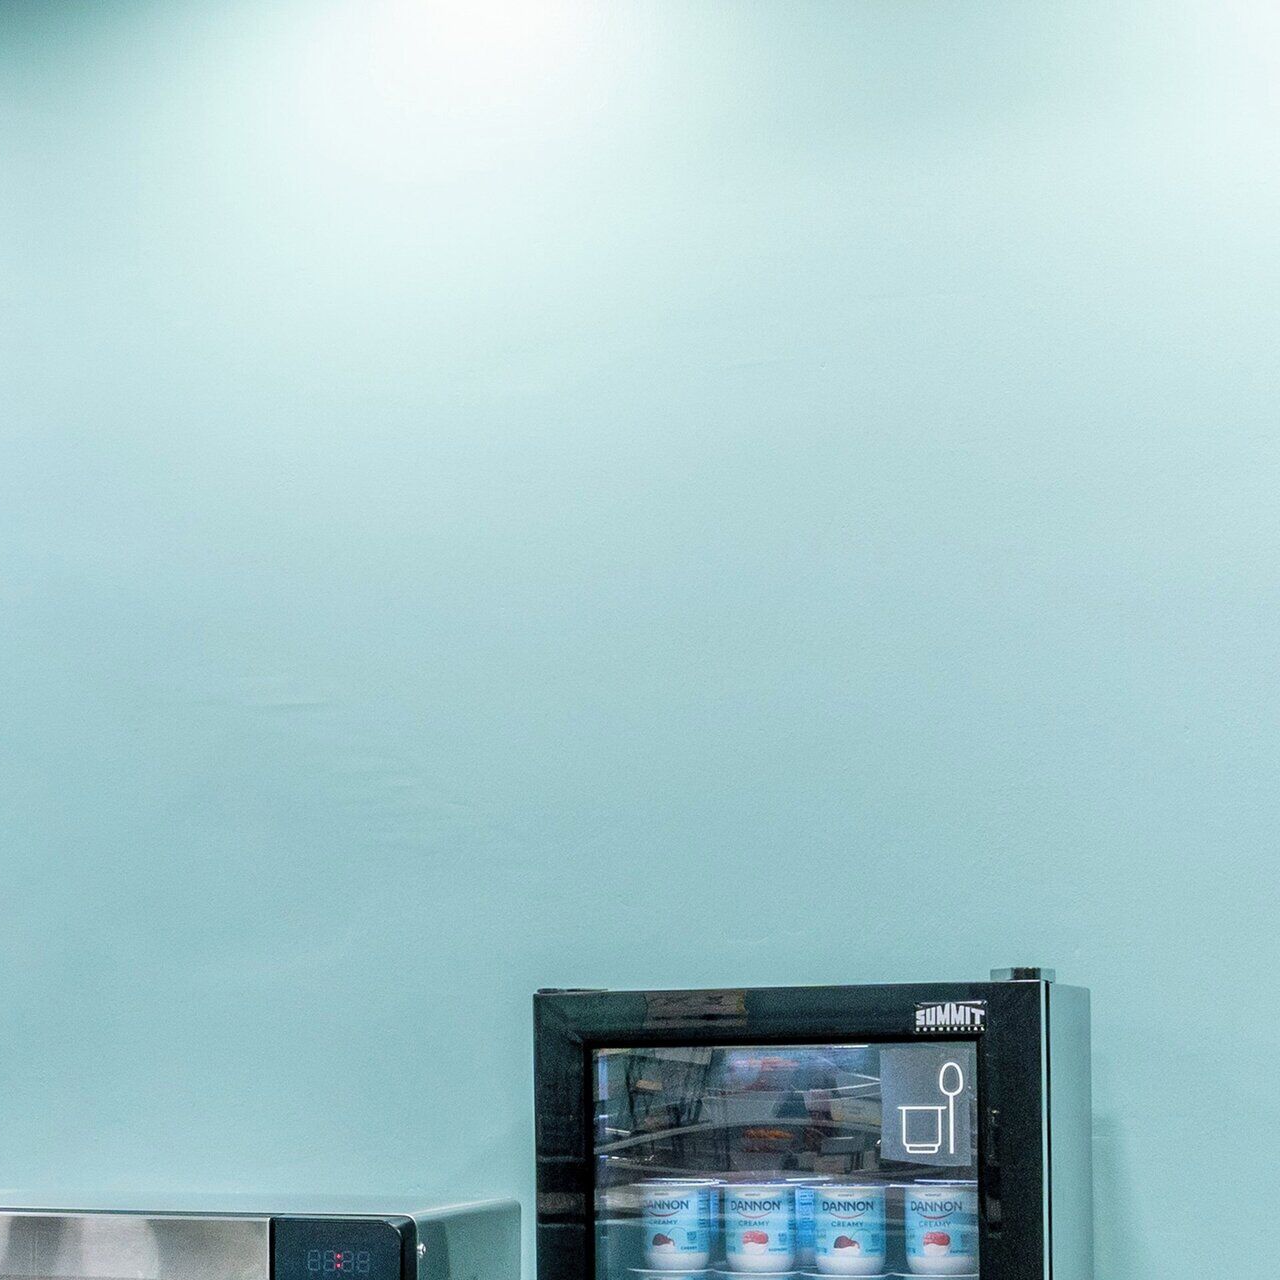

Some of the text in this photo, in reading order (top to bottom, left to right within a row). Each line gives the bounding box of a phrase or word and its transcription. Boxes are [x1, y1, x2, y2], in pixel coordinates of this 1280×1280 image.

[915, 1002, 986, 1026] SUMMIT
[730, 1200, 781, 1211] DANNON
[822, 1200, 874, 1211] DANNON
[910, 1200, 963, 1212] DANNON
